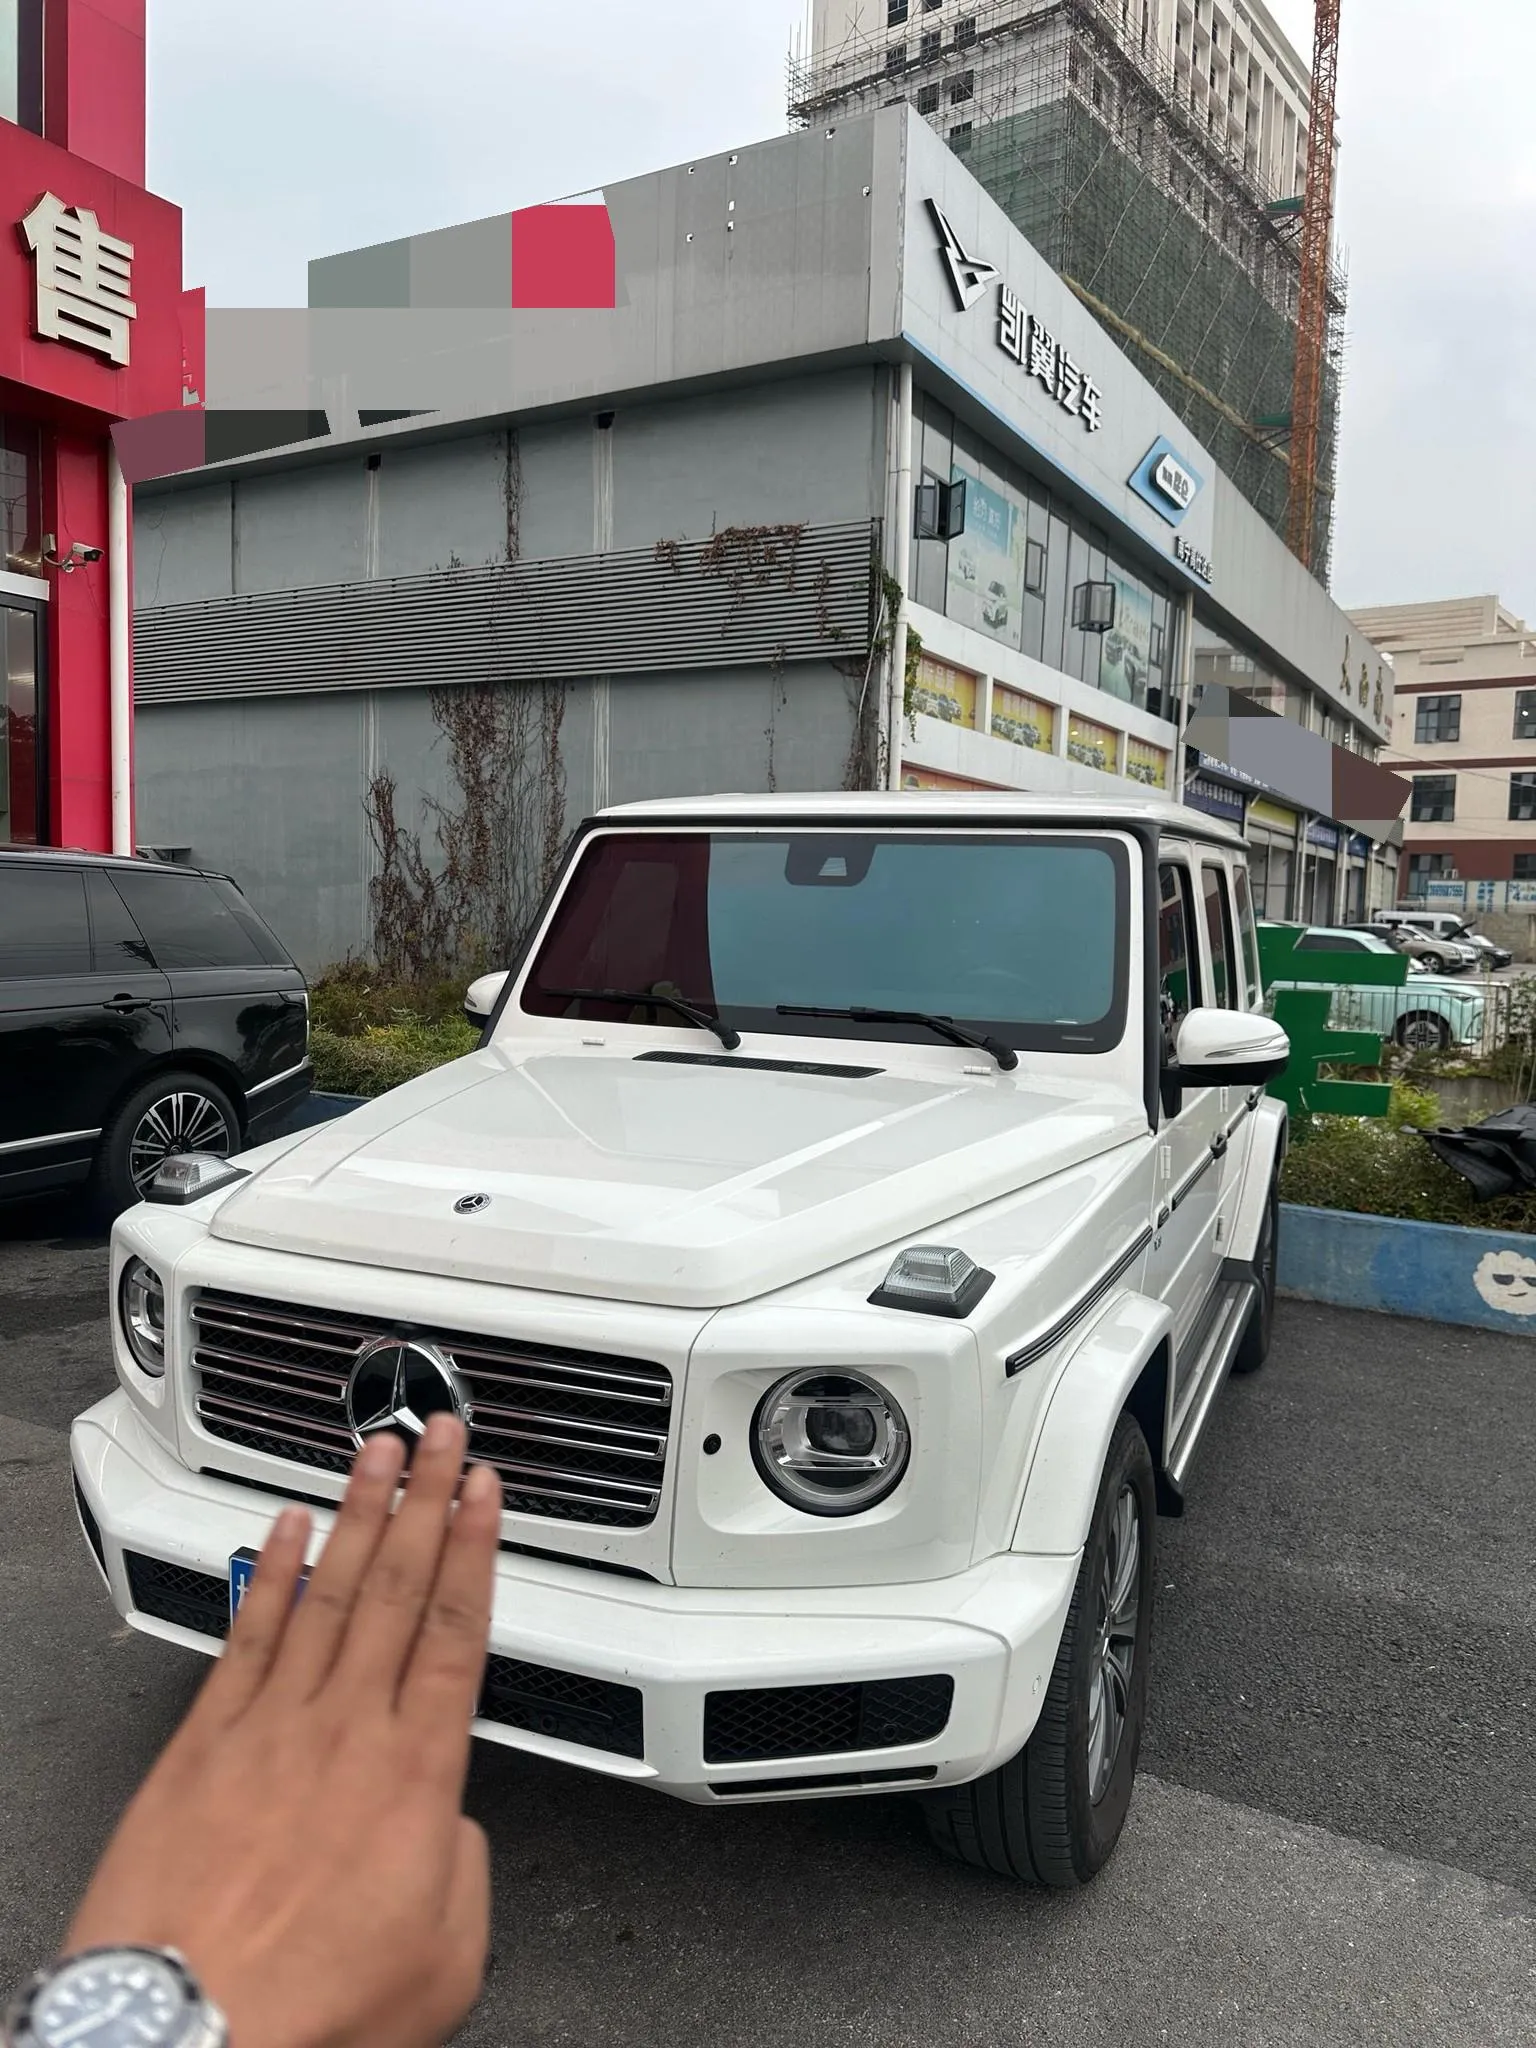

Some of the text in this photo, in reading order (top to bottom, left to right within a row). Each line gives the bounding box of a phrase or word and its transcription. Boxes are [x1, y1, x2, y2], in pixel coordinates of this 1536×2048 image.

[18, 190, 137, 368] 售
[997, 284, 1101, 431] 凯翼汽车
